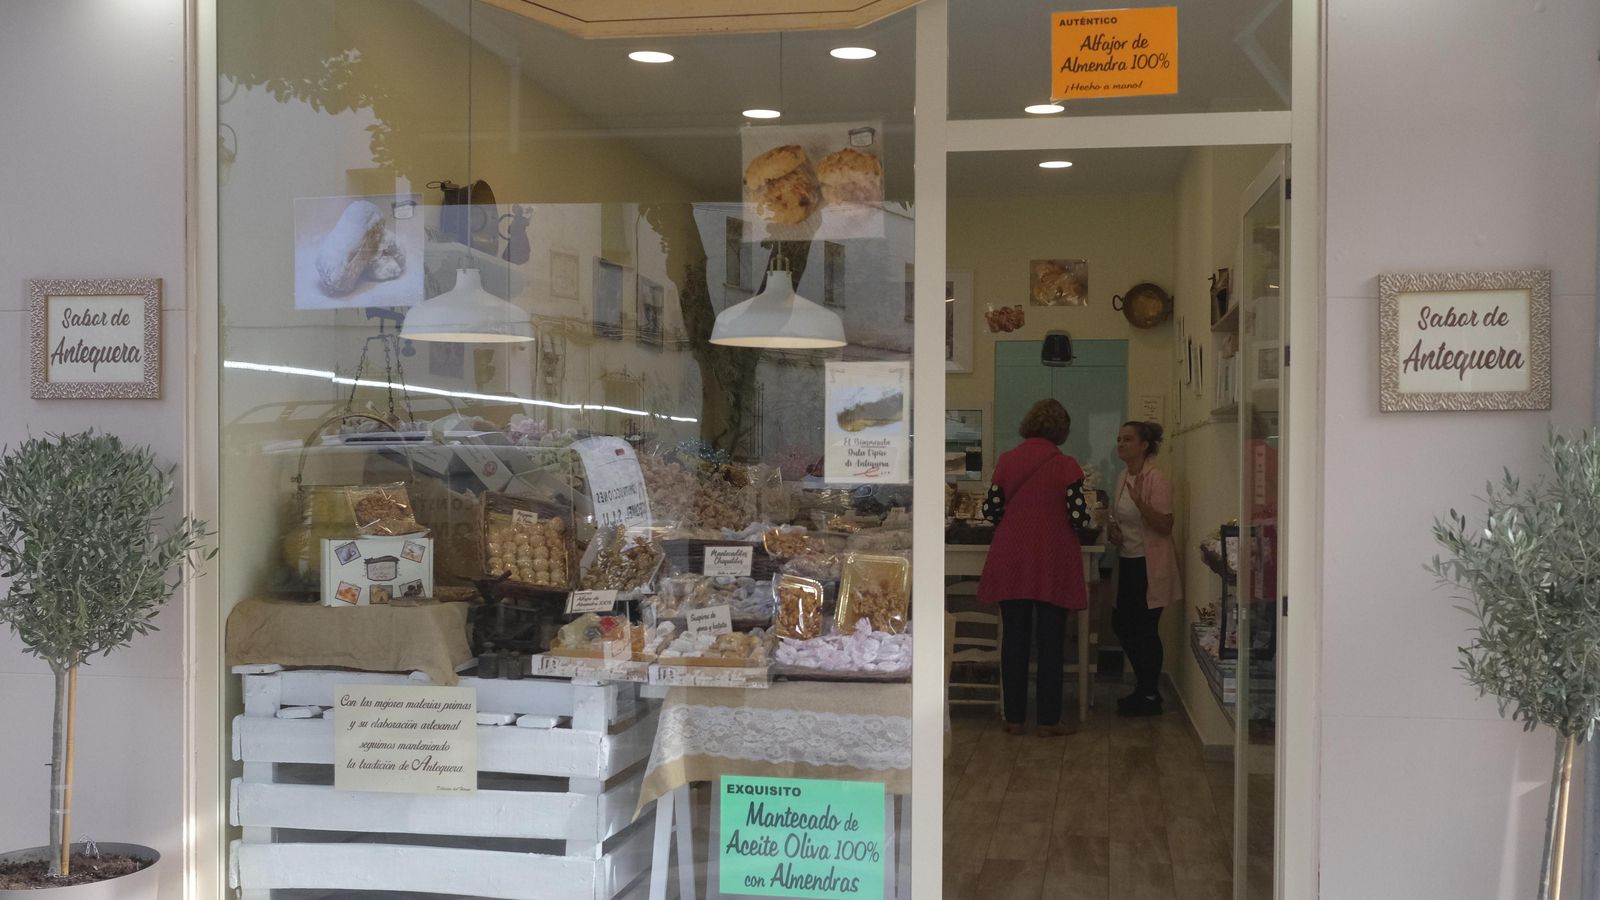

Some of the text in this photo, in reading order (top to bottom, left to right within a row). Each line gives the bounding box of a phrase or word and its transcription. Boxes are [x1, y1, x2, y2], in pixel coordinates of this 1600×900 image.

[1059, 17, 1118, 27] AUTÉNTICO
[1080, 33, 1149, 55] Alfajor de
[1060, 52, 1170, 73] Almendra 100%
[62, 307, 131, 329] Sabor de
[1418, 305, 1509, 331] Sabor de
[50, 336, 142, 373] Antequera
[1402, 338, 1525, 381] Antequera
[340, 694, 472, 713] Con las mejores materias primas
[347, 719, 356, 731] y
[370, 717, 418, 730] elaboración
[420, 719, 462, 731] artesanal
[358, 739, 450, 752] seguimos manteniendo
[346, 758, 356, 769] la
[359, 758, 396, 771] tradición
[398, 760, 409, 770] de
[726, 784, 802, 797] EXQUISITO
[746, 801, 860, 832] Mantecado de
[726, 829, 880, 863] Aceite Oliva 100%
[744, 862, 860, 893] con Almendras
